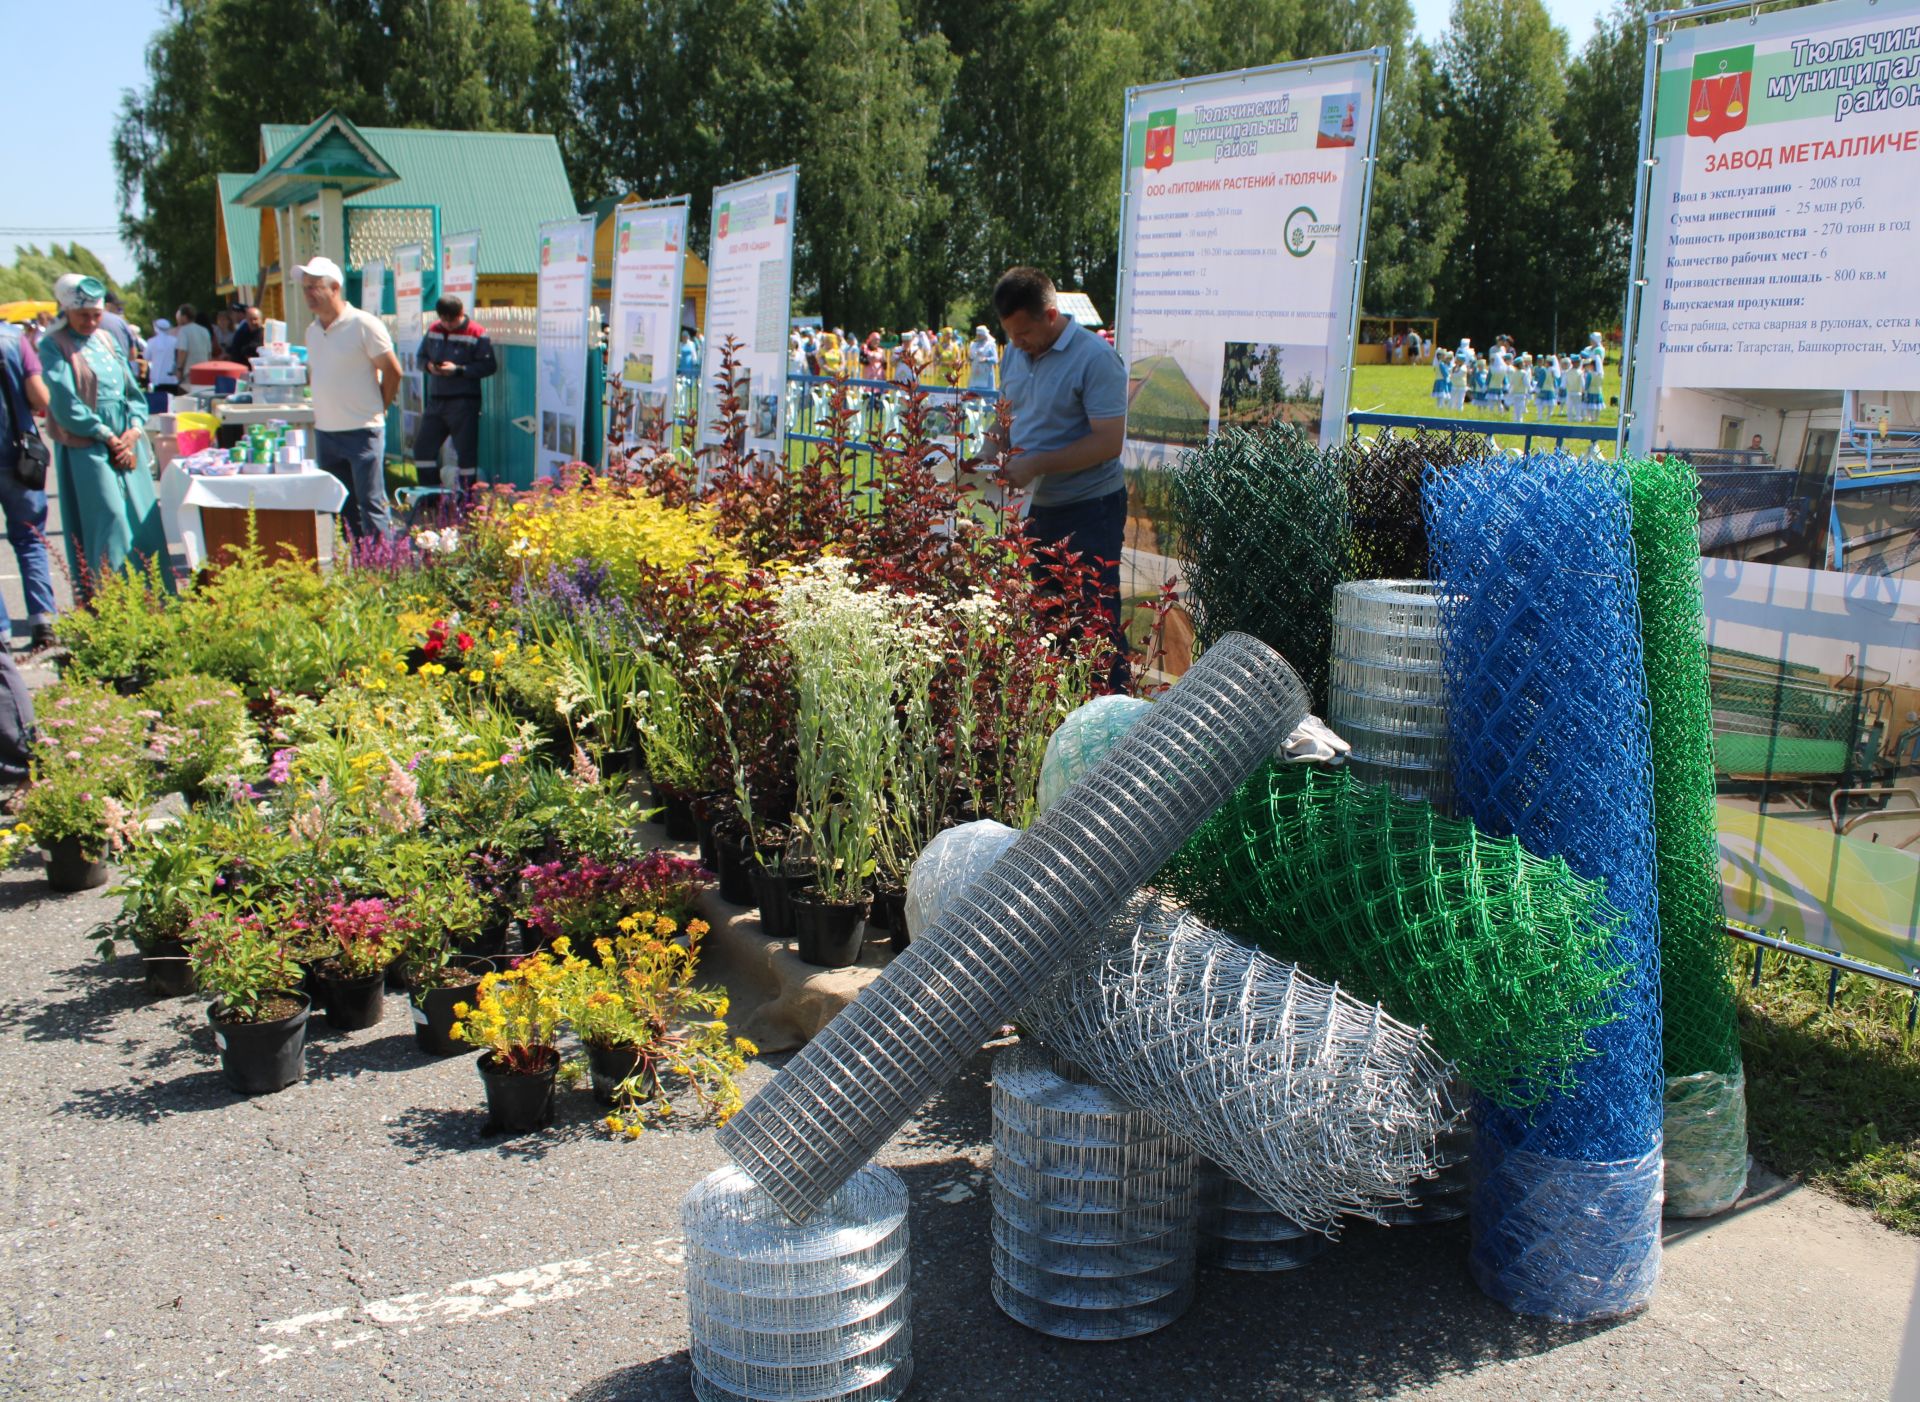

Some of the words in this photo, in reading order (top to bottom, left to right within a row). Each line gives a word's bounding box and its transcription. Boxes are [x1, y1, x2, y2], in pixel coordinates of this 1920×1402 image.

[1791, 26, 1920, 67] Тюлячин
[1767, 55, 1920, 101] муниципал
[1194, 93, 1290, 125] Тюлячинский
[1835, 81, 1920, 122] район
[1183, 112, 1298, 148] муниципальный
[1214, 139, 1258, 164] район
[1704, 148, 1773, 173] ЗАВОД
[1779, 131, 1920, 165] МЕТАЛЛИЧЕ
[1146, 184, 1166, 197] ООО
[1167, 179, 1221, 195] «ПИТОМНИК
[1223, 172, 1276, 190] РАСТЕНИЙ
[1278, 171, 1337, 186] «ТЮЛЯЧИ»
[1672, 192, 1698, 204] Ввод
[1709, 184, 1792, 200] эксплуатацию
[1809, 176, 1838, 190] 2008
[1840, 177, 1861, 188] год
[1670, 213, 1706, 227] Сумма
[1708, 204, 1776, 222] инвестиций
[1796, 201, 1811, 214] 25
[1813, 203, 1837, 213] млн
[1840, 197, 1865, 214] руб.
[1307, 223, 1341, 234] ТЮЛЯЧИ
[1728, 227, 1807, 244] производства
[1821, 222, 1843, 236] 270
[1846, 223, 1875, 234] тонн
[1879, 223, 1886, 232] в
[1890, 220, 1911, 232] год
[1667, 255, 1728, 268] Количество
[1731, 250, 1778, 267] рабочих
[1782, 250, 1809, 261] мест
[1820, 247, 1827, 259] 6
[1664, 276, 1765, 292] Производственная
[1768, 273, 1823, 284] площадь
[1834, 269, 1856, 282] 800
[1859, 270, 1887, 281] кв.м
[1663, 299, 1735, 312] Выпускаемая
[1737, 297, 1805, 311] продукция:
[1660, 320, 1688, 333] Сетка
[1690, 320, 1729, 335] рабица,
[1732, 320, 1761, 330] сетка
[1763, 320, 1807, 333] сварная
[1810, 320, 1817, 329] в
[1820, 319, 1872, 332] рулонах,
[1876, 318, 1910, 328] сетка
[1658, 341, 1693, 354] Рынки
[1696, 341, 1733, 353] сбыта:
[1736, 341, 1794, 356] Татарстан,
[1798, 340, 1887, 356] Башкортостан,
